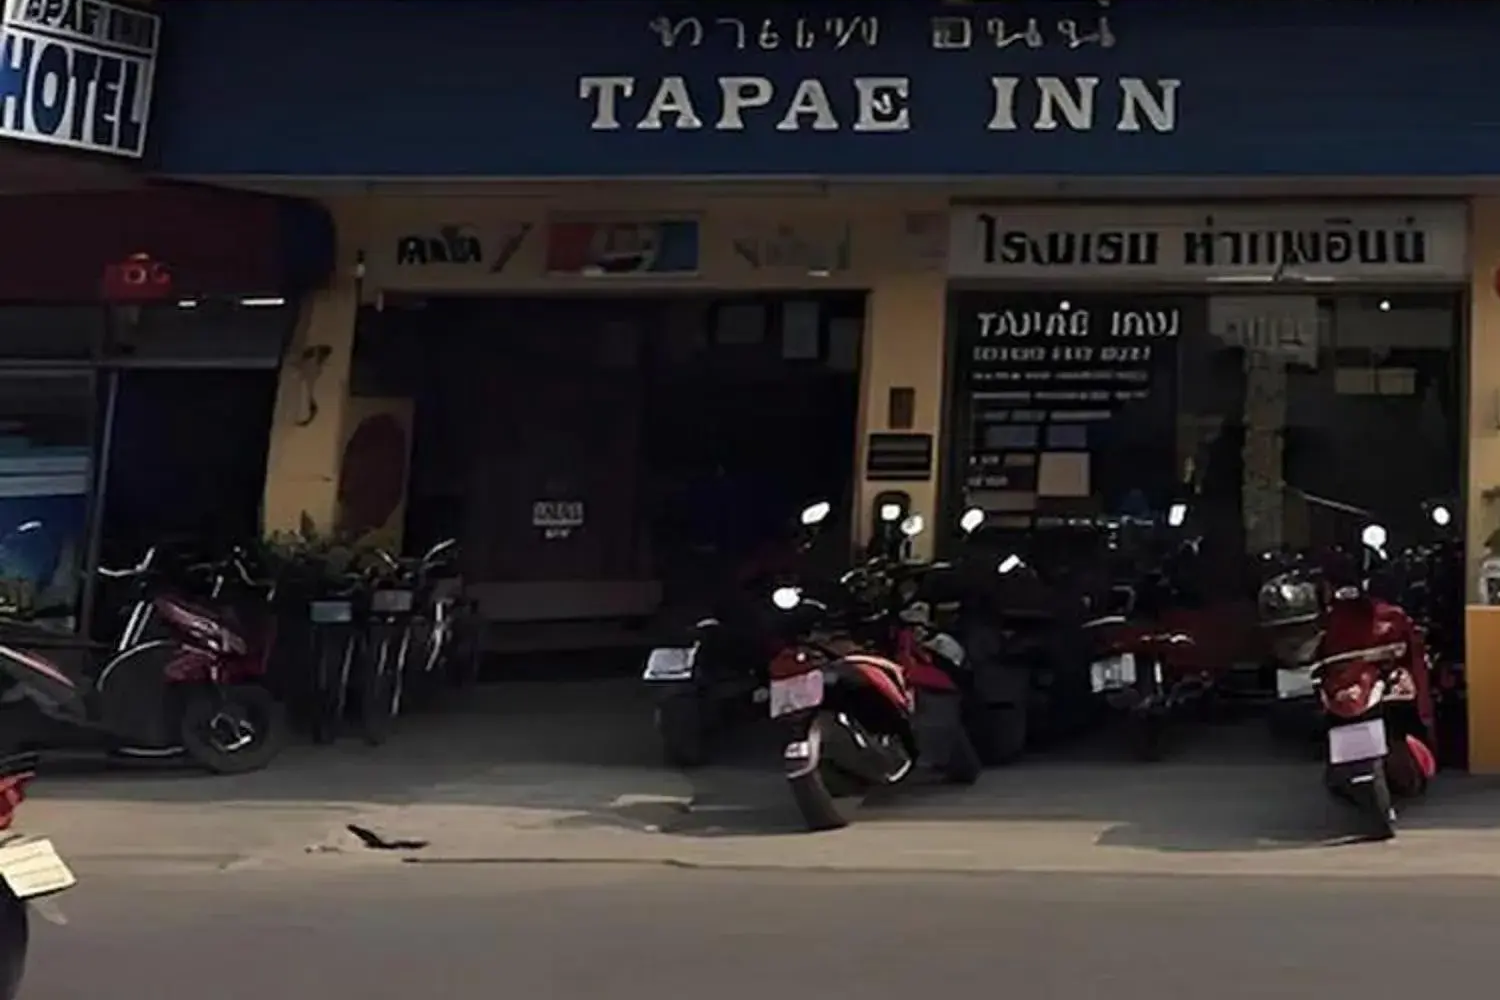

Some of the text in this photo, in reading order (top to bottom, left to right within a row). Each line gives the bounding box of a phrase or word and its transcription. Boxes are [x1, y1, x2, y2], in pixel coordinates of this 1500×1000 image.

[0, 31, 143, 151] HOTEL
[579, 75, 1182, 132] TAPAE INN
